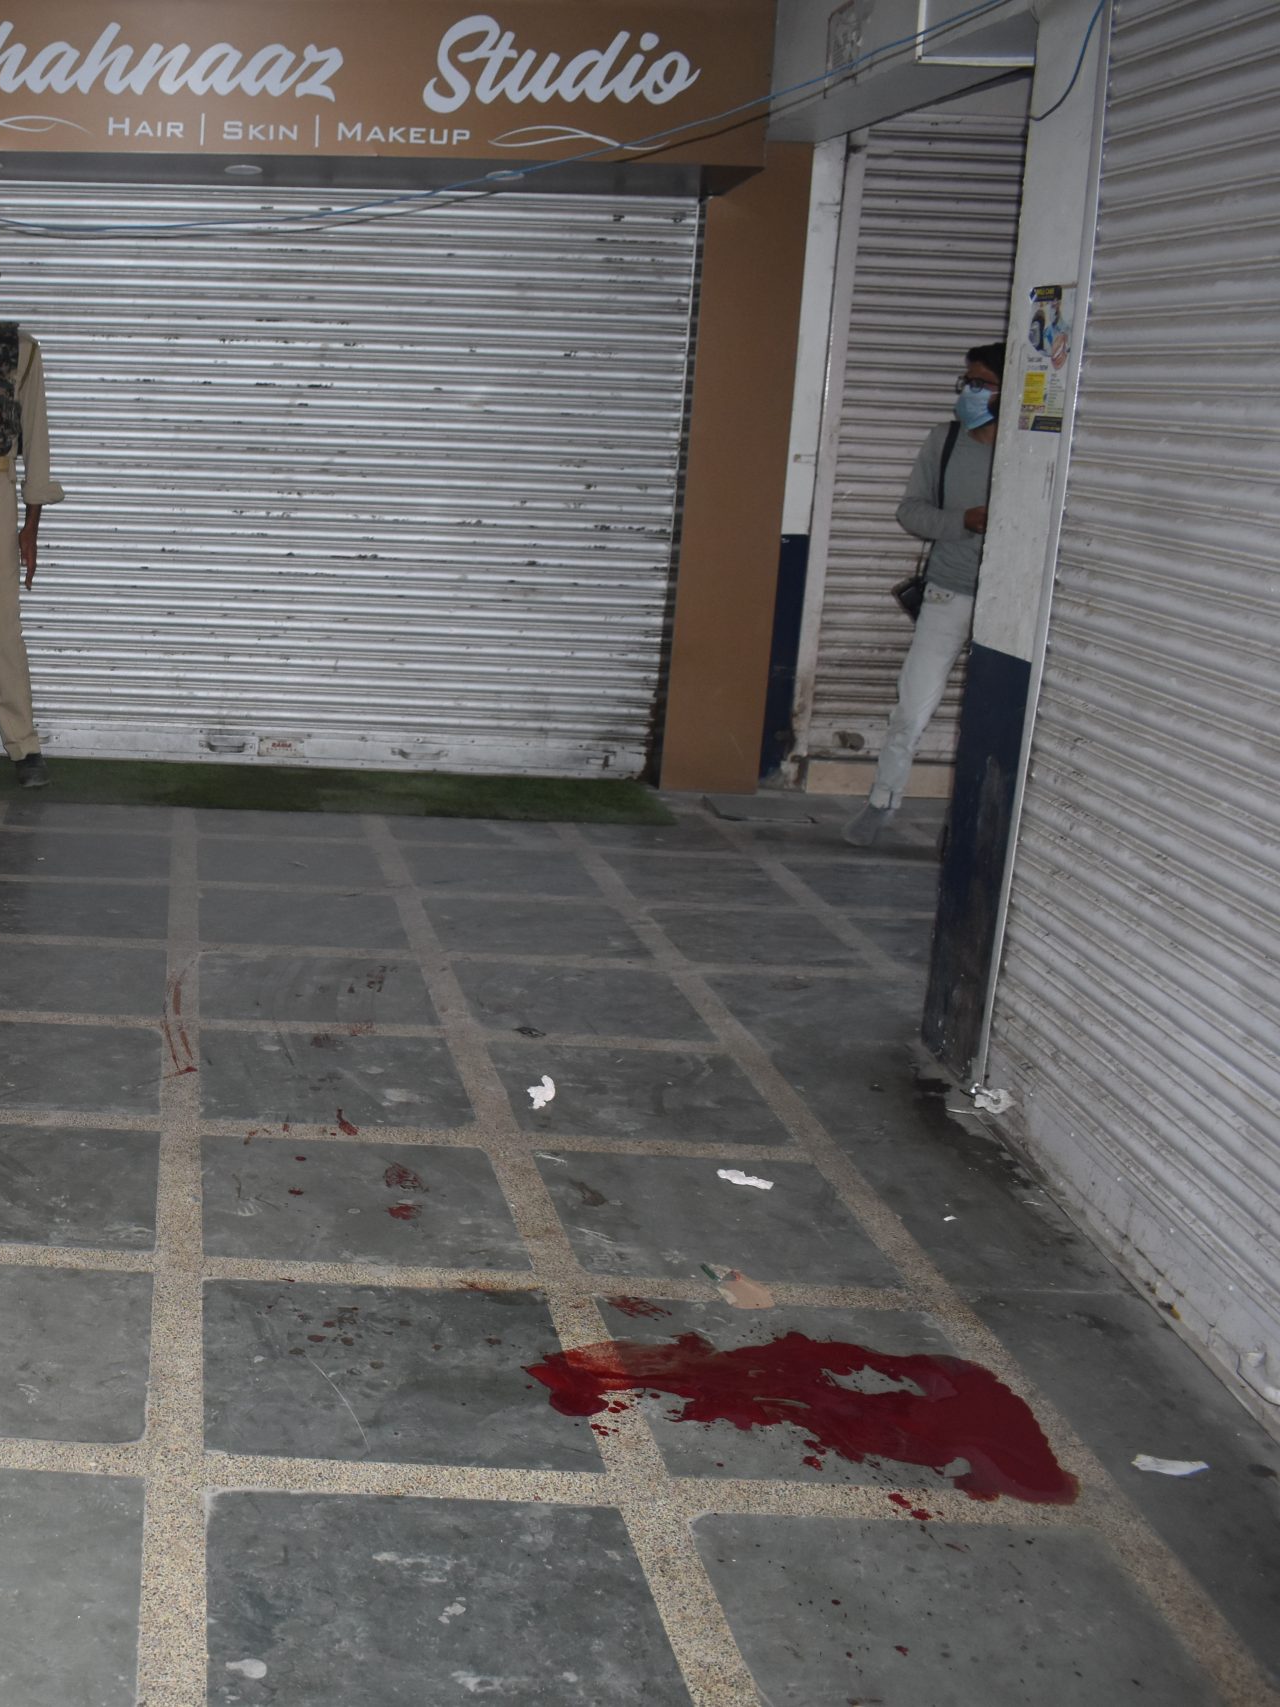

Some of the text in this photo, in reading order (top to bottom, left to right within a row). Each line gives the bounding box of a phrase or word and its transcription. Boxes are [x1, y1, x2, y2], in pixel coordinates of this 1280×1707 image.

[423, 15, 701, 113] Studio
[107, 116, 470, 145] HAIR SKIN MAKEUP
